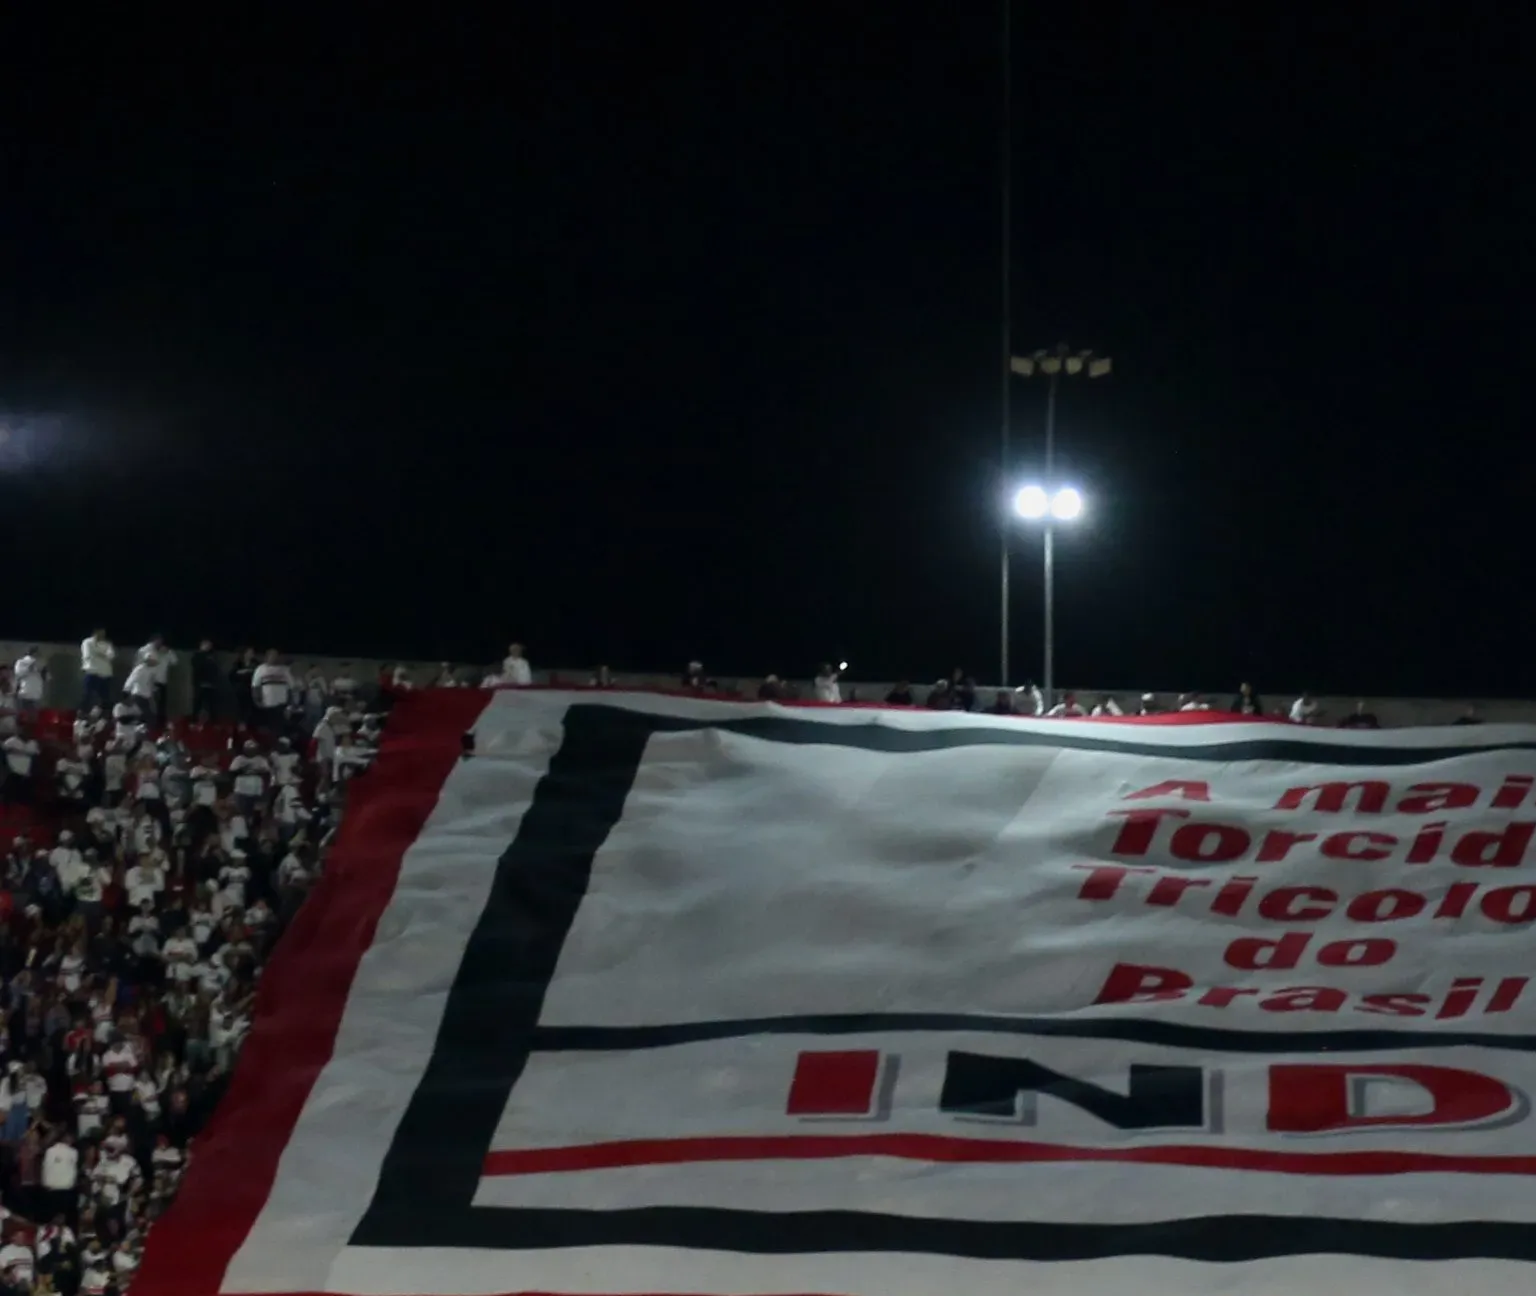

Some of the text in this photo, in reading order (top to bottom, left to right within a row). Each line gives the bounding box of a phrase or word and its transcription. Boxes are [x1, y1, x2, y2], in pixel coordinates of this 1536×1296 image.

[1122, 780, 1213, 803] A
[1222, 932, 1398, 972] do
[1090, 963, 1530, 1020] Brasil
